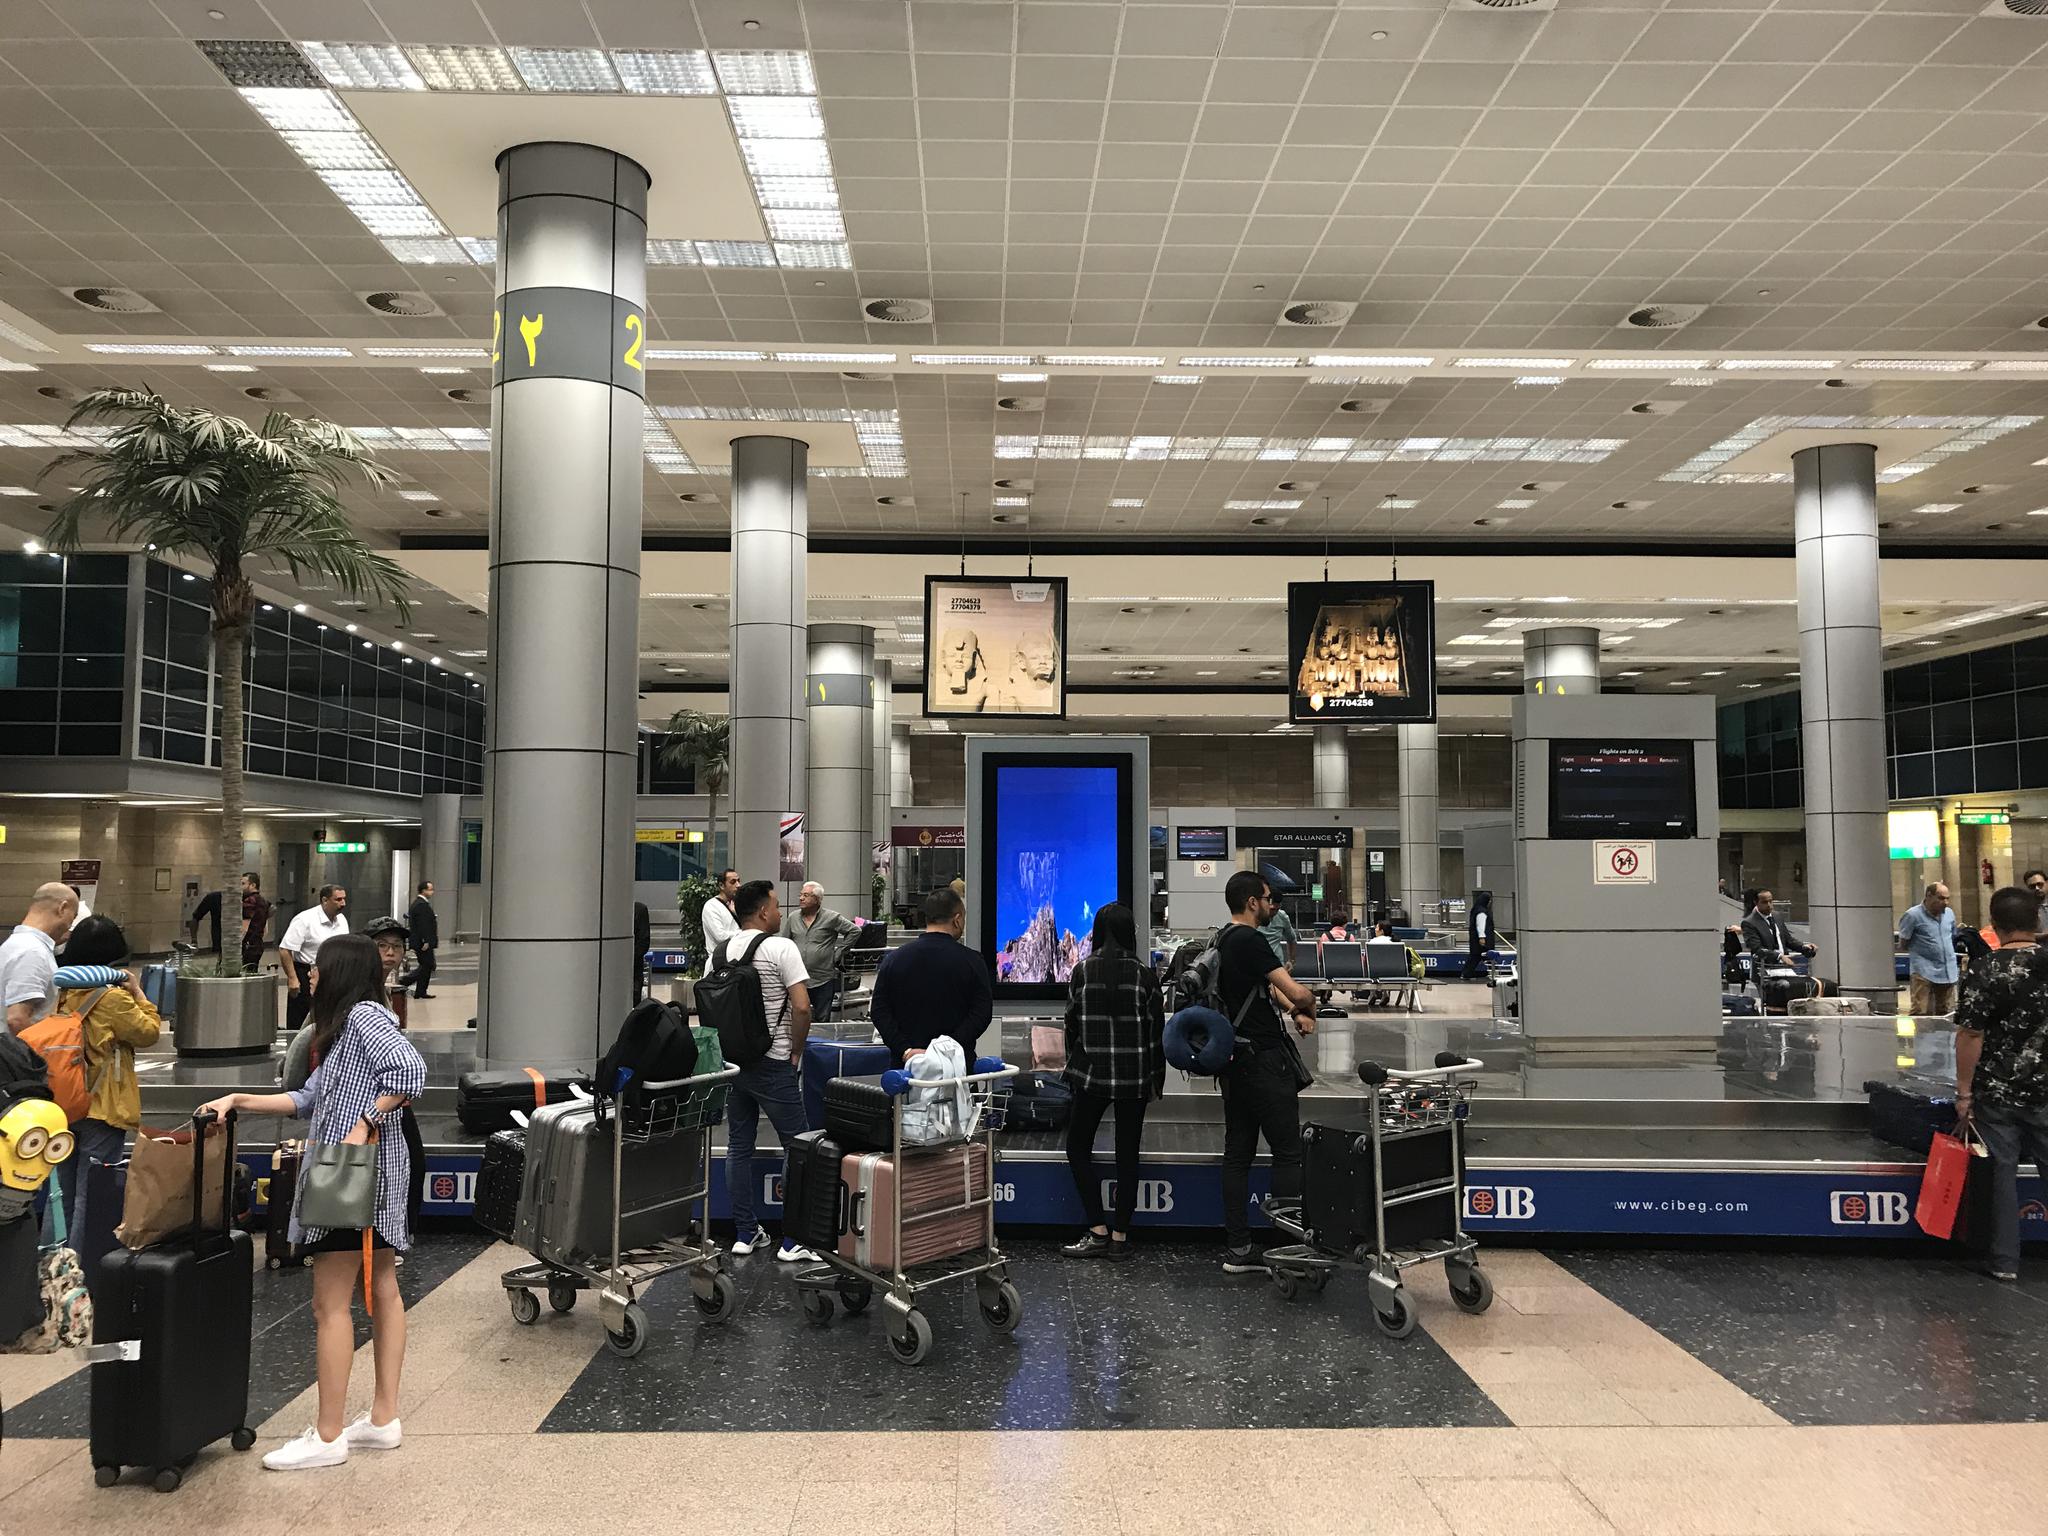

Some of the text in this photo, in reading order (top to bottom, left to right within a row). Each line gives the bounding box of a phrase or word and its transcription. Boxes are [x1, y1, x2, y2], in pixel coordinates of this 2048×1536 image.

[624, 314, 643, 371] 2
[1329, 699, 1374, 707] 27704256
[1463, 1186, 1536, 1219] CIB
[1614, 1199, 1749, 1213] www.cibeg.com
[1830, 1191, 1910, 1225] CIB
